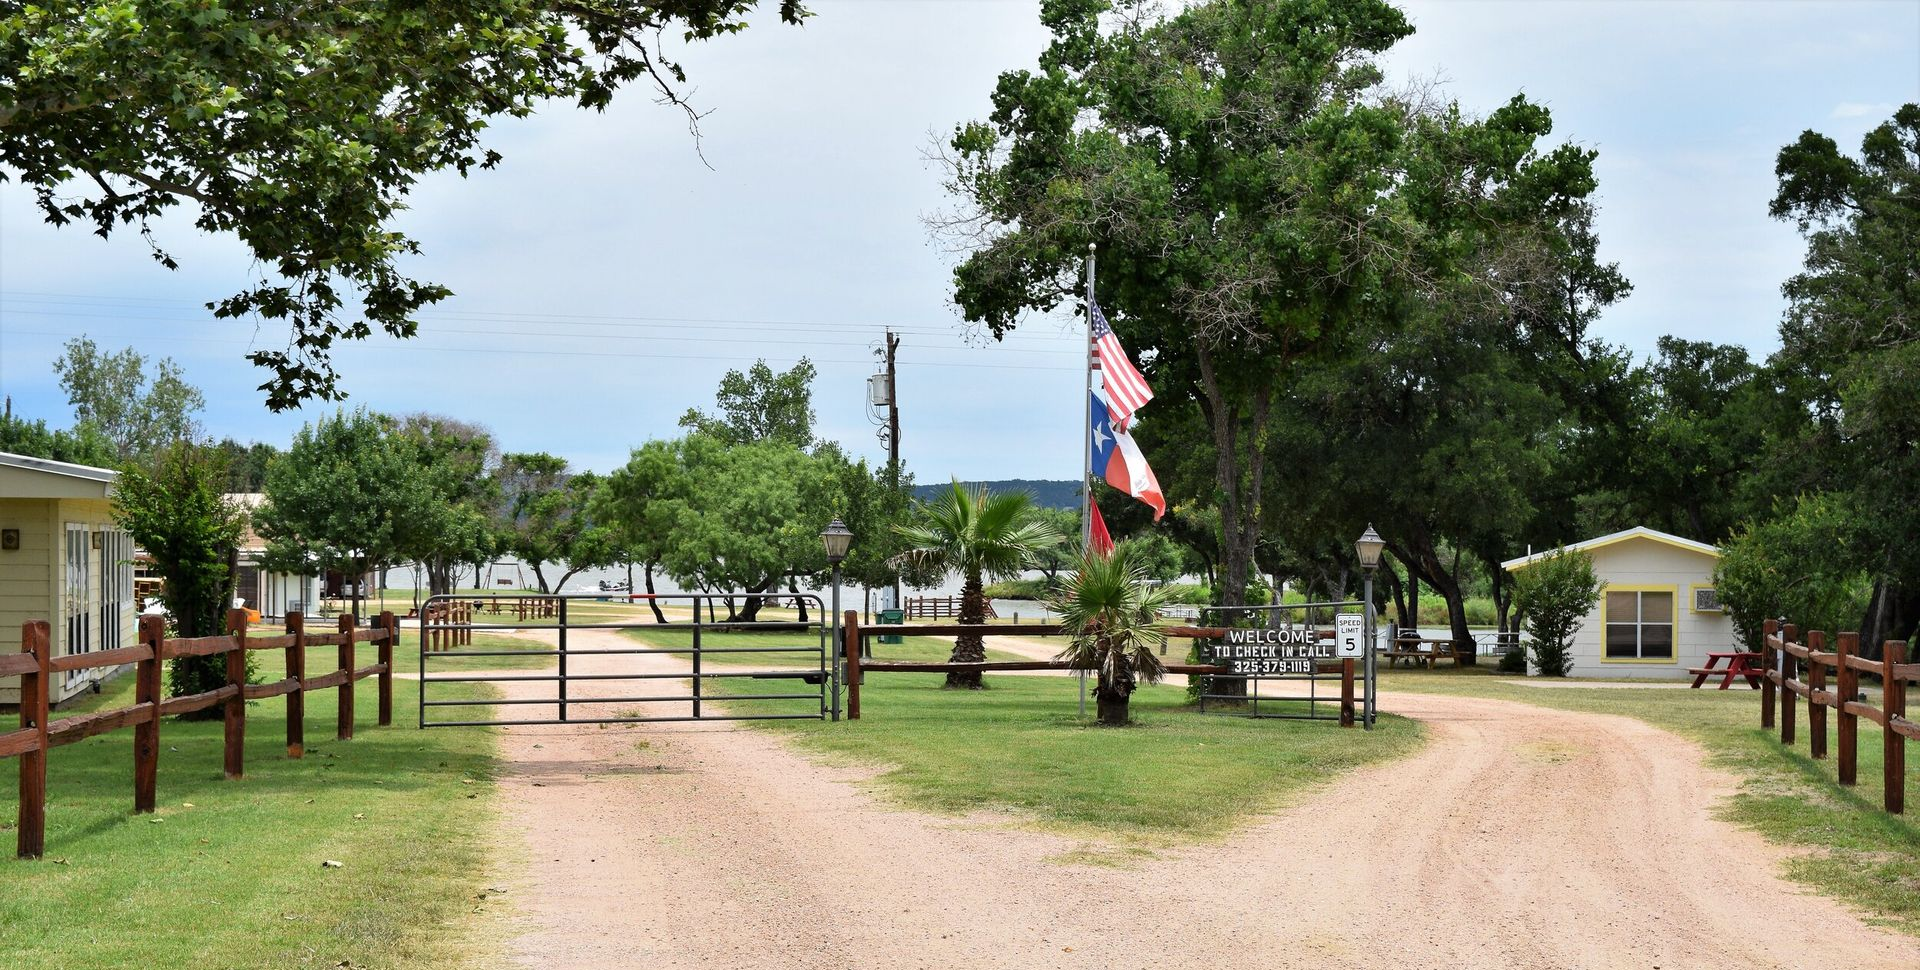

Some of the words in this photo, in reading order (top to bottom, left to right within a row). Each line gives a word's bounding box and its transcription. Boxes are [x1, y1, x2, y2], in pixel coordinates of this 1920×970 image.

[1339, 619, 1361, 627] SPEED
[1229, 630, 1315, 644] WELCOME
[1345, 638, 1356, 651] 5
[1214, 645, 1230, 657] TO
[1235, 645, 1276, 657] CHECK
[1281, 645, 1294, 657] IN
[1299, 645, 1330, 657] CALL
[1234, 661, 1311, 673] 325-379-1119
